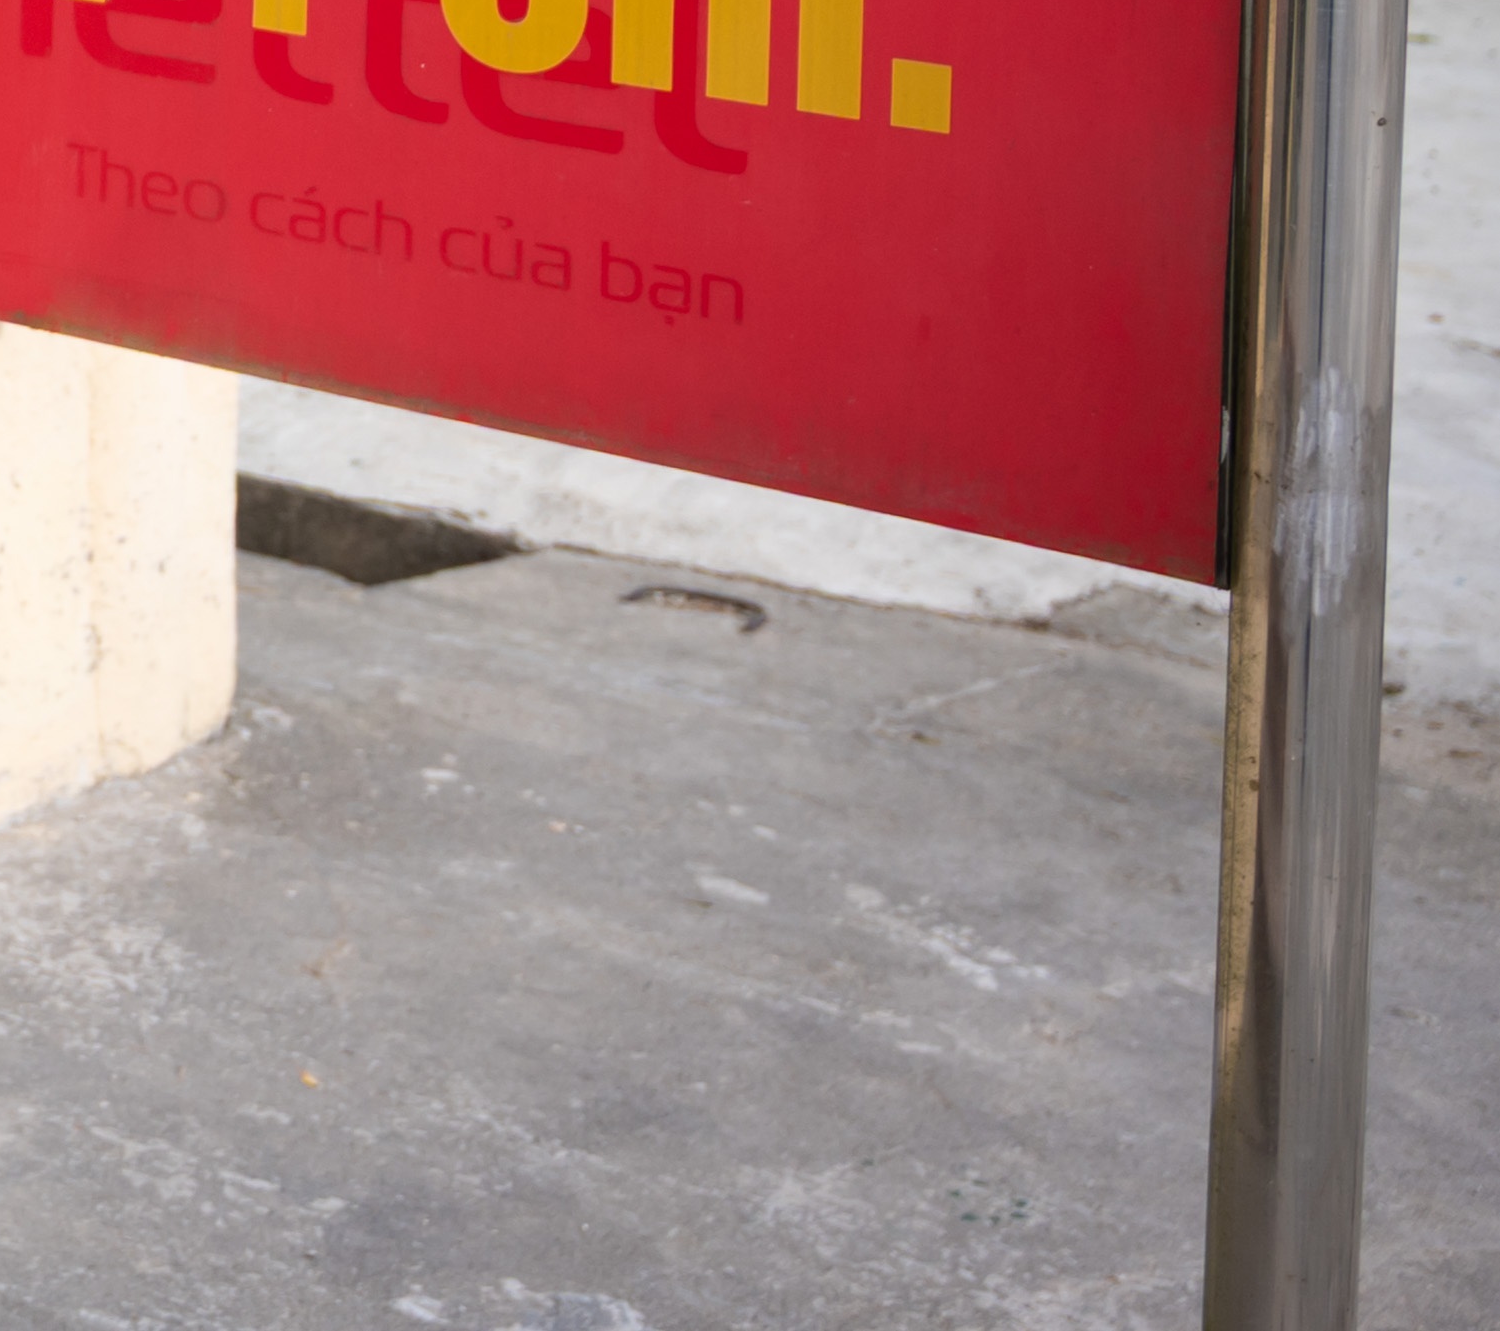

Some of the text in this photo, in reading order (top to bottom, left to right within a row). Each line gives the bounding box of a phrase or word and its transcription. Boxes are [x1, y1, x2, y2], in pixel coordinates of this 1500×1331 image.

[67, 141, 745, 326] Theo cách của bạn
